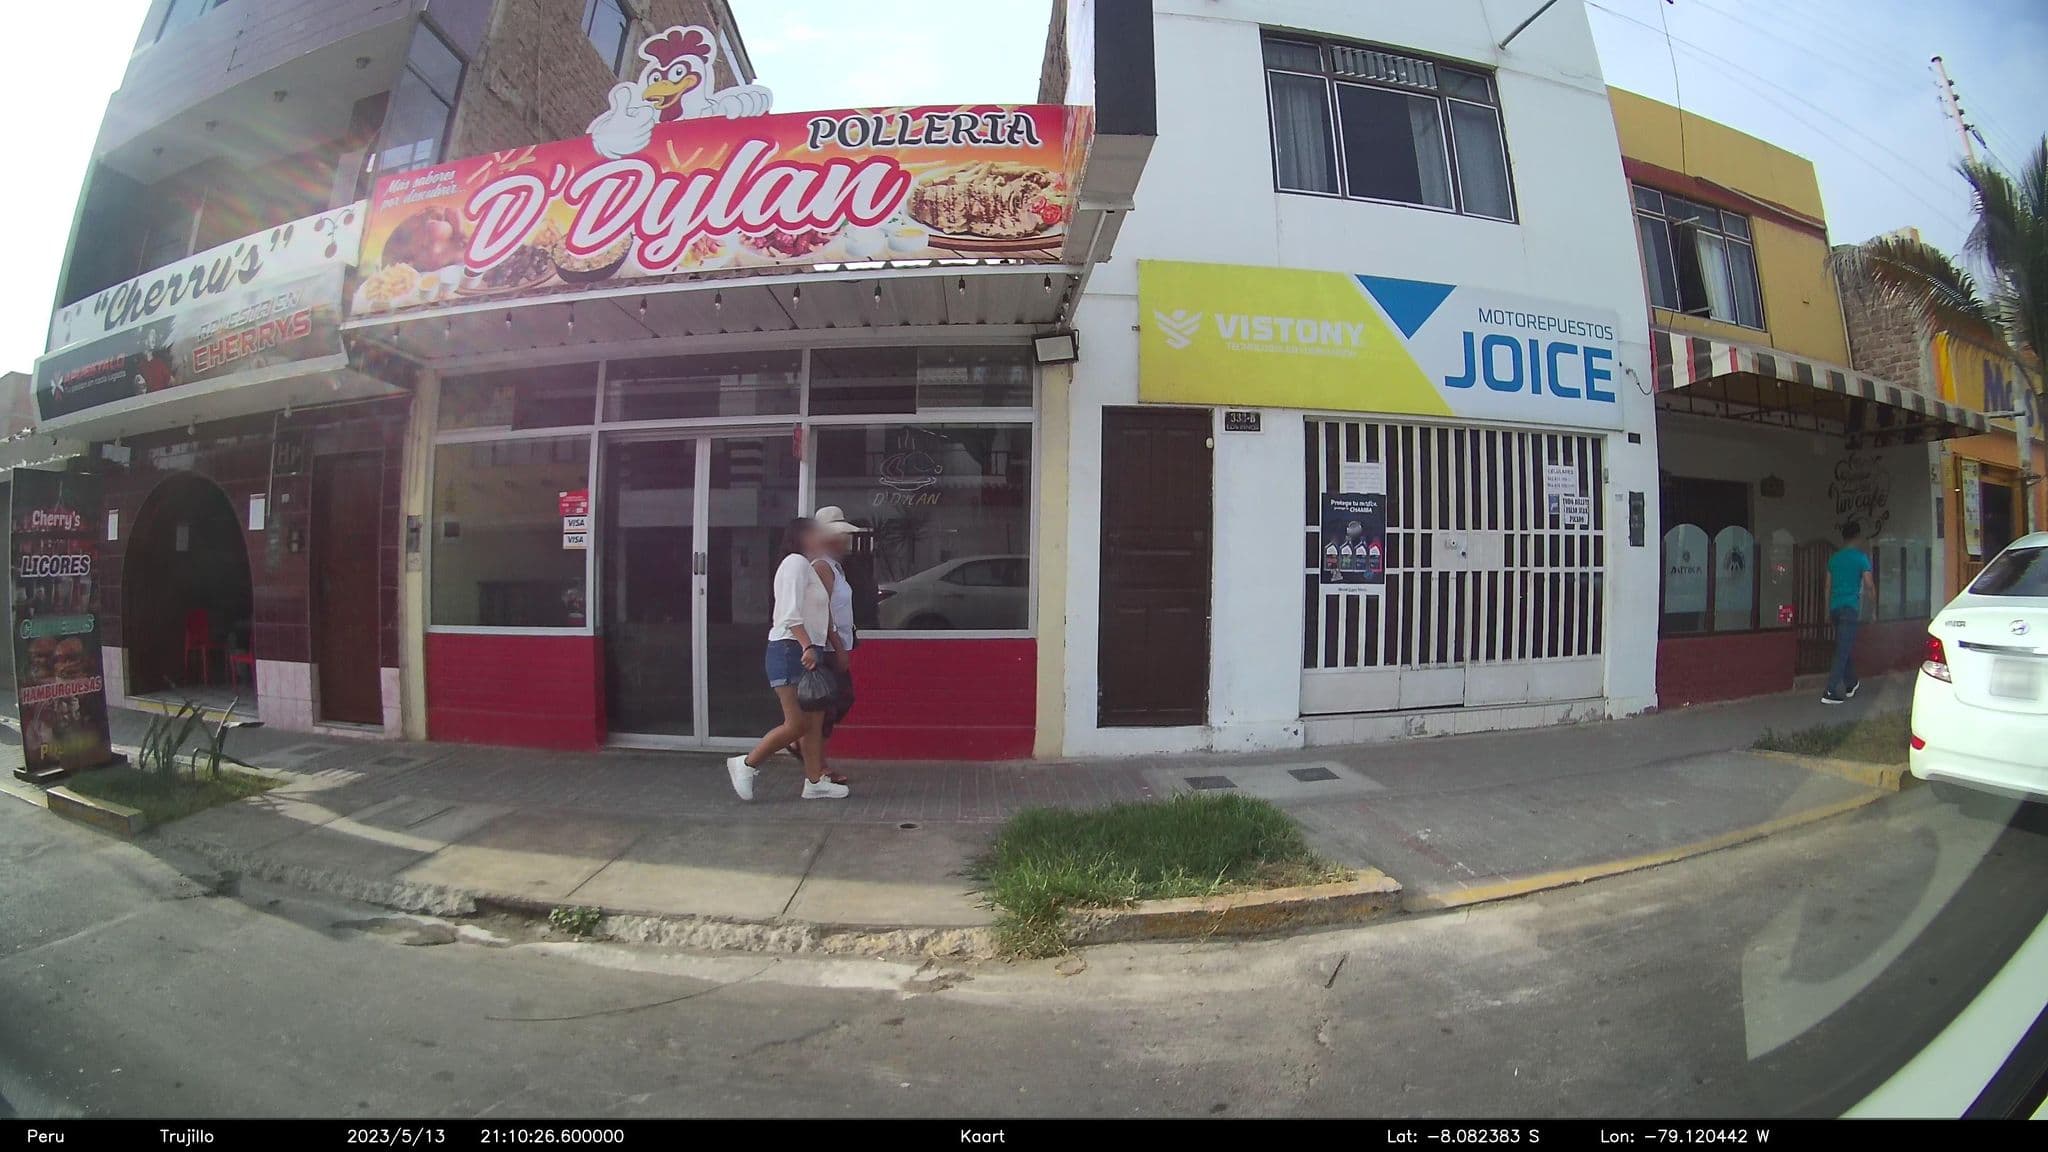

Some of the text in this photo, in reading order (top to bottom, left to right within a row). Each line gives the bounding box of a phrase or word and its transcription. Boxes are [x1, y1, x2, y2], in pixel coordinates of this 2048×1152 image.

[808, 111, 1042, 151] POLLERIA
[1215, 313, 1365, 346] VISTONY
[1478, 307, 1614, 341] MOTOREPUESTOS
[193, 306, 313, 374] CHERRYS
[1444, 330, 1616, 403] JOICE
[32, 510, 81, 530] Cherry's
[567, 519, 585, 528] VISA
[567, 535, 584, 544] VISA
[21, 555, 91, 578] LICORES
[21, 677, 103, 704] HAMBURGUESAS
